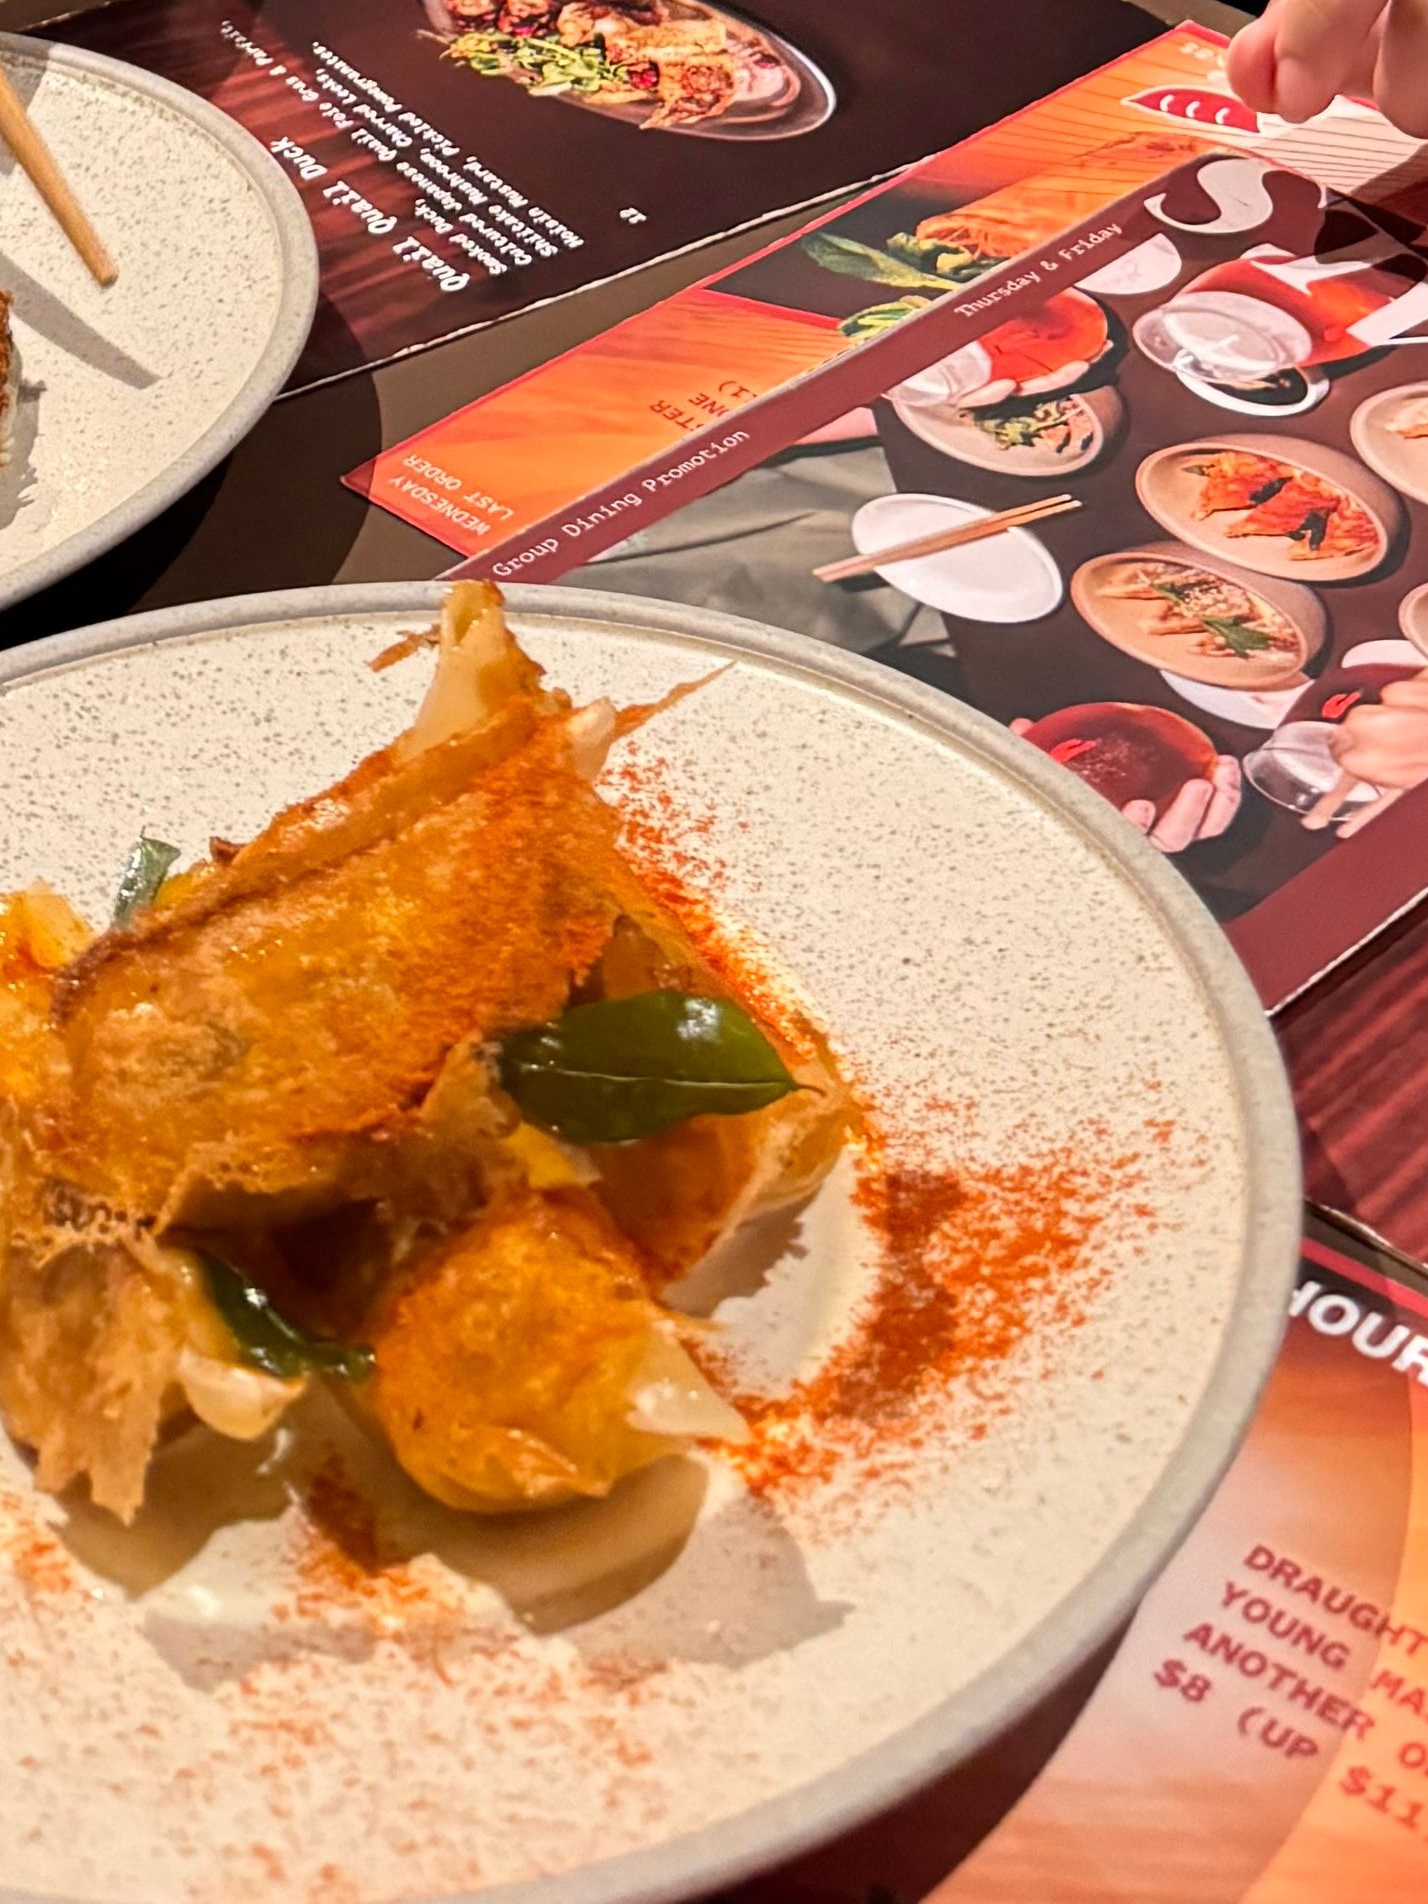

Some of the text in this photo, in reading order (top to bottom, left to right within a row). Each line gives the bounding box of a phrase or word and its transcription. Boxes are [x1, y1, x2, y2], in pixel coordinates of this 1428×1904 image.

[263, 136, 471, 292] Quail Quail Duck
[414, 198, 508, 275] Smoked Duck,
[492, 539, 559, 578] Group
[560, 493, 643, 539] Dining
[641, 428, 751, 493] Promotion
[953, 266, 1041, 319] Thursday
[1058, 223, 1123, 261] Friday
[387, 460, 491, 536] WEDNESDAY
[402, 454, 515, 521] LAST ORDER
[1220, 1580, 1351, 1672] YOUNG
[1153, 1658, 1212, 1704] $8
[1237, 1705, 1320, 1760] (UP
[1183, 1622, 1375, 1741] ANOTHER
